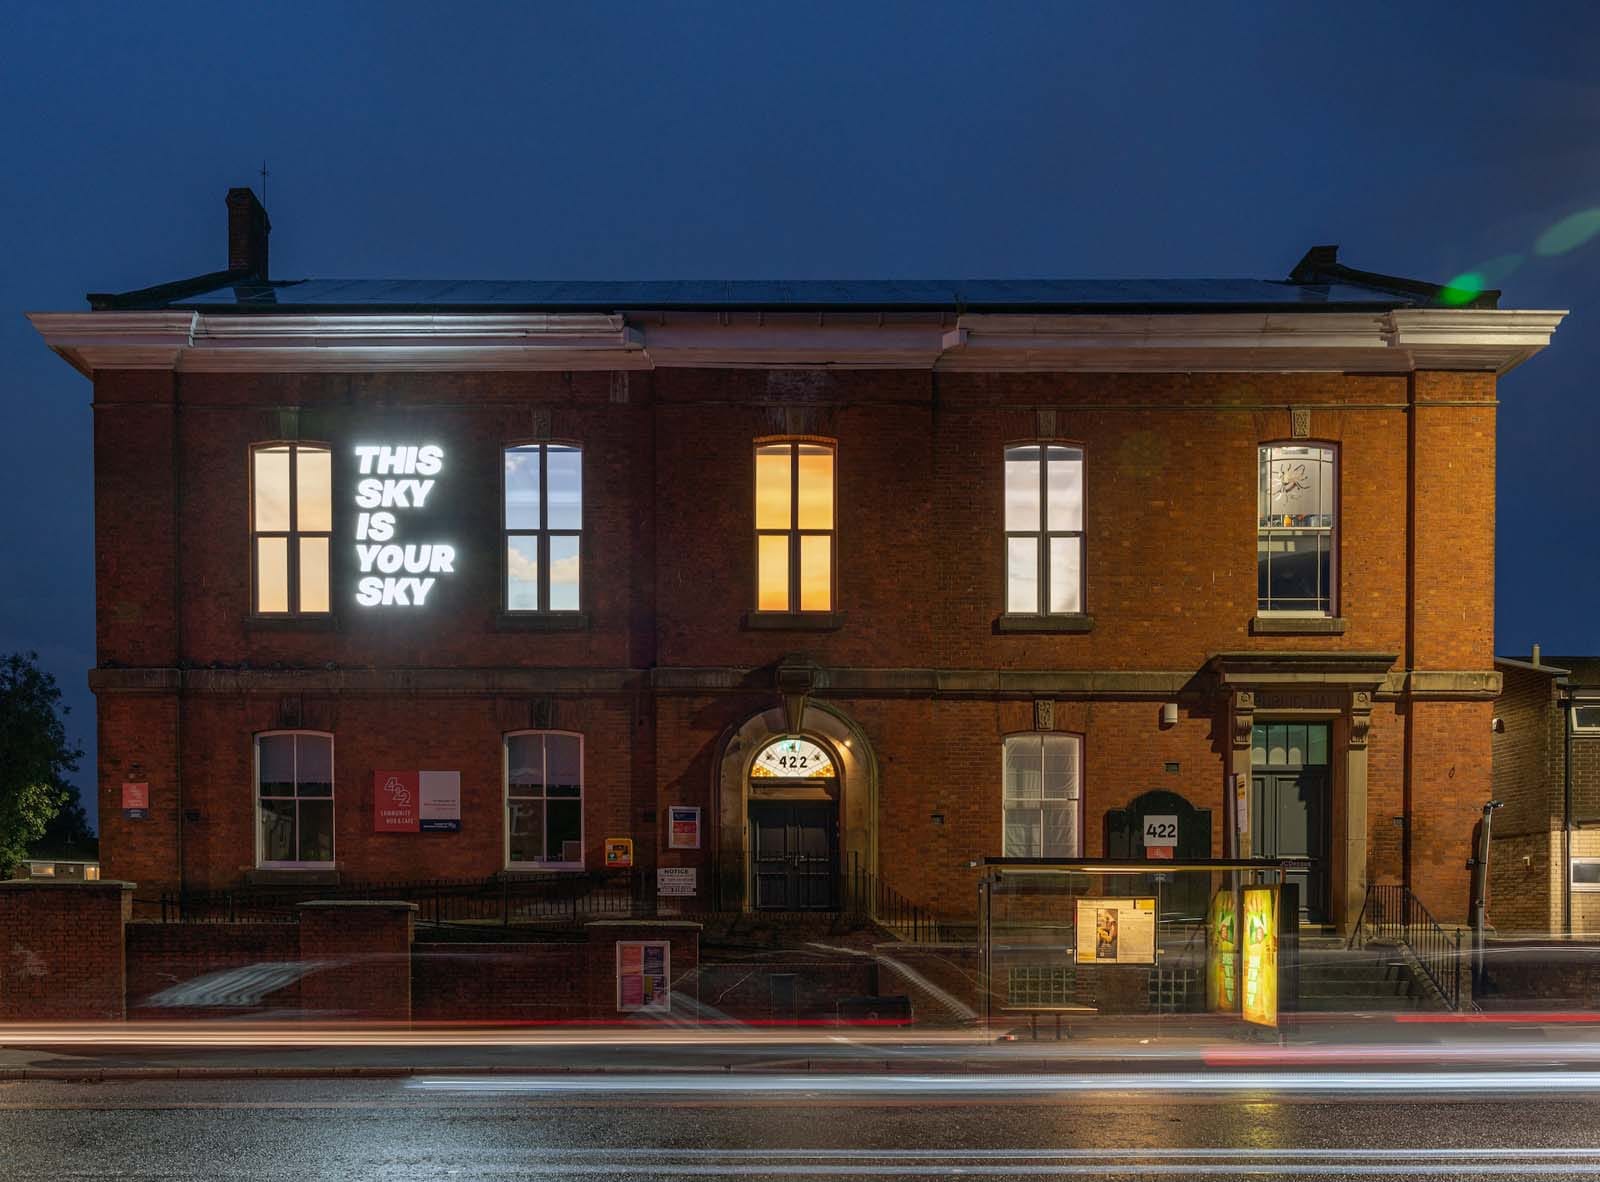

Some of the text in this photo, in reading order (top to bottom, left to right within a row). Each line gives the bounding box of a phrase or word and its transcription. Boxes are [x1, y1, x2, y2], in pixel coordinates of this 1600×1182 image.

[355, 445, 444, 475] THIS
[355, 479, 435, 508] SKY
[356, 512, 396, 542] IS
[355, 544, 456, 573] YOUR
[356, 576, 436, 606] SKY
[779, 756, 808, 768] 422
[1146, 823, 1176, 838] 422
